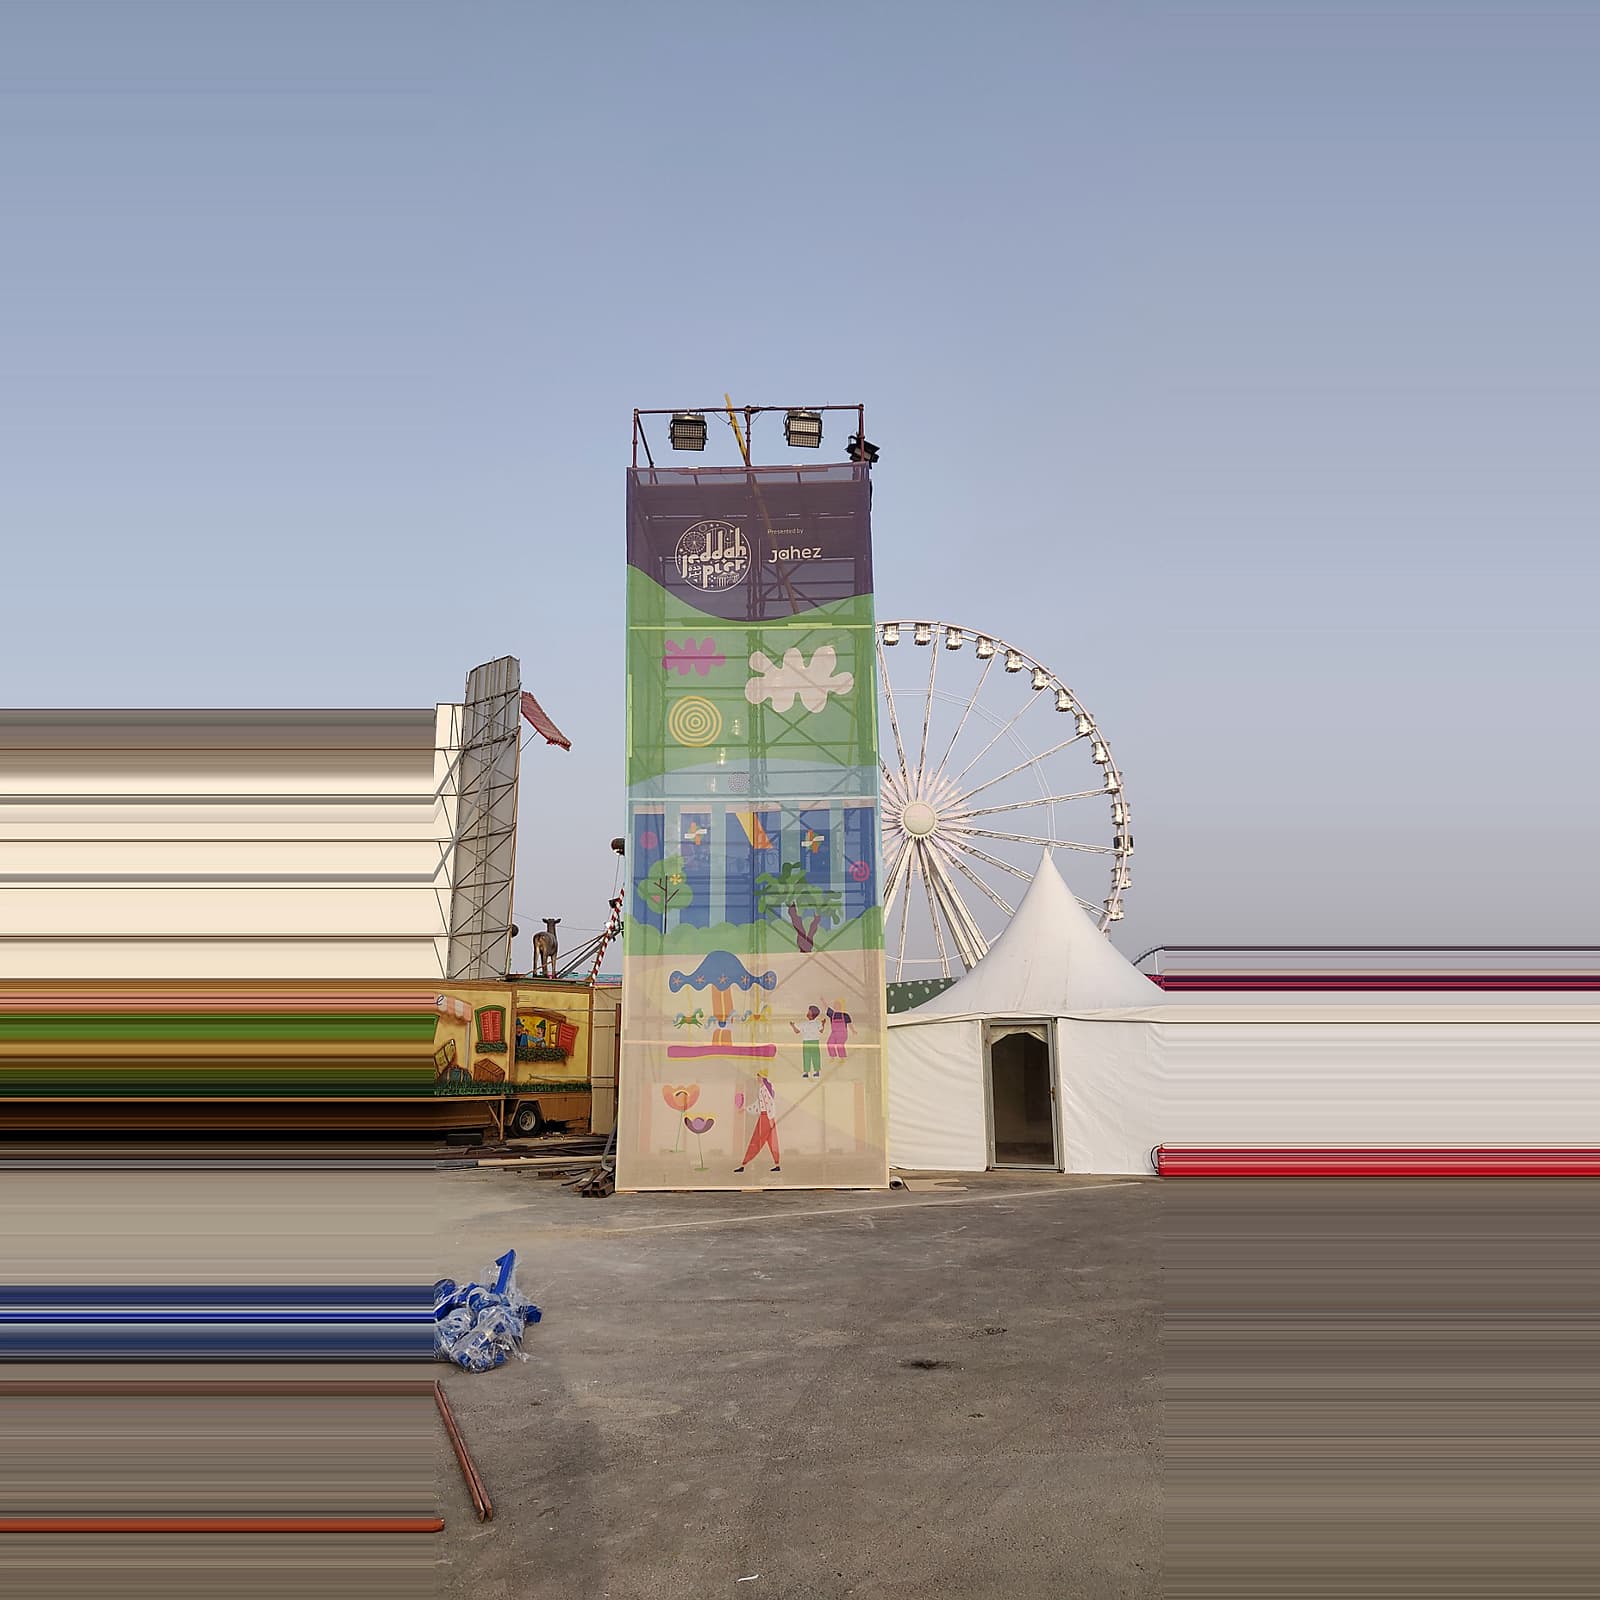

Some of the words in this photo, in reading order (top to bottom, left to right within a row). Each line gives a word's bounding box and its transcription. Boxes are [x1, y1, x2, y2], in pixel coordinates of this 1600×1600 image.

[681, 527, 747, 578] jeddah
[768, 545, 822, 563] jahez
[702, 560, 746, 588] pier
